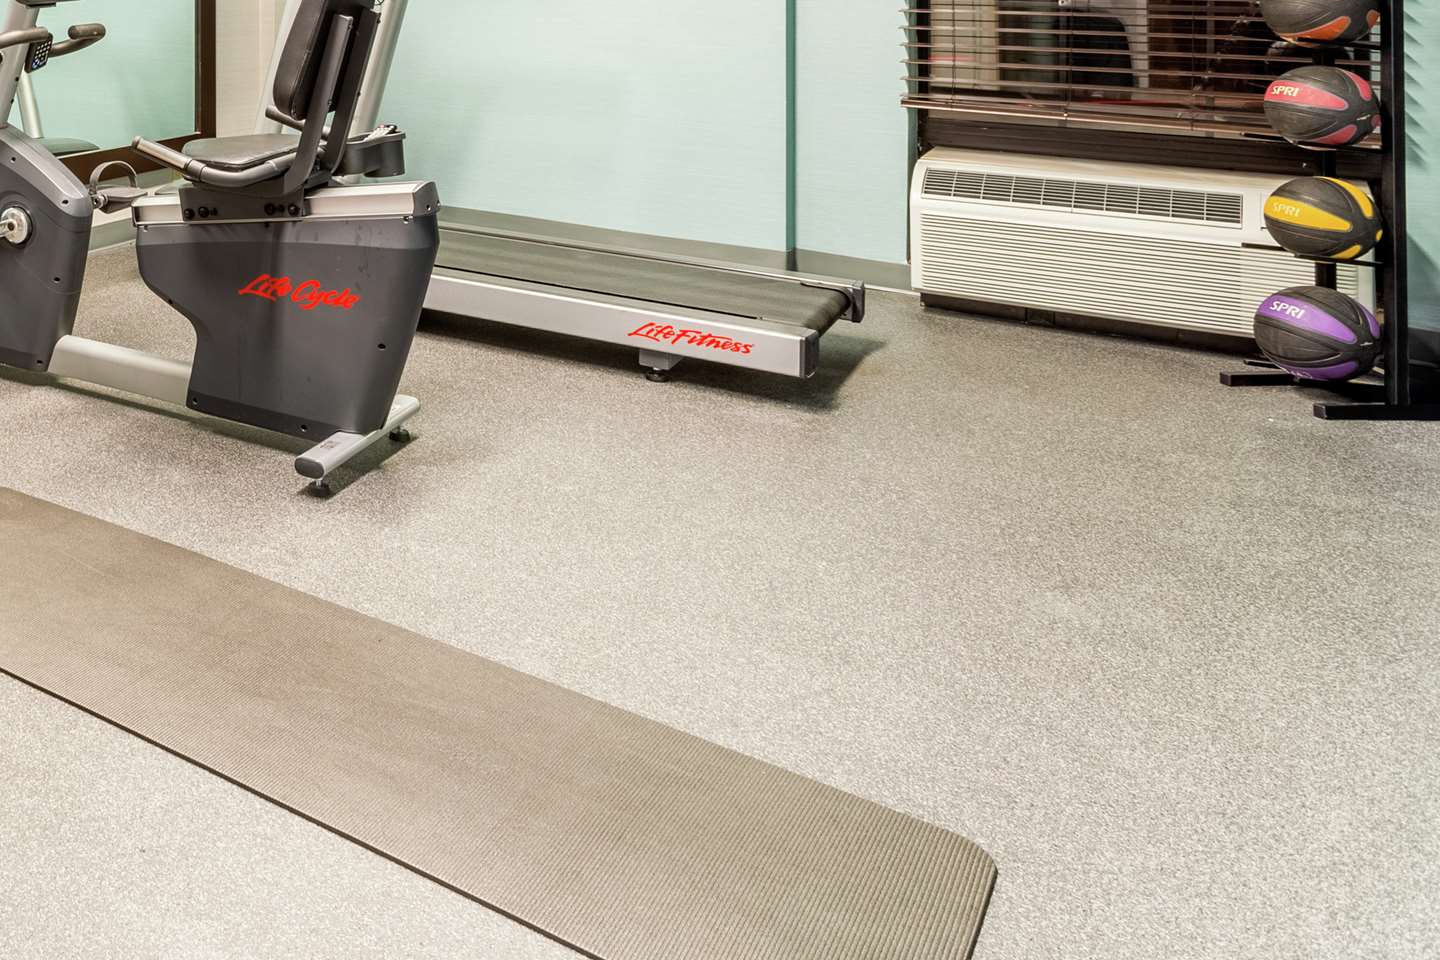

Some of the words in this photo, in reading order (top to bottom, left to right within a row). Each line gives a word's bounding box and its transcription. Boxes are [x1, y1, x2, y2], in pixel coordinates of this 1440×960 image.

[1271, 85, 1301, 97] SPRI
[1272, 202, 1301, 217] SPRI
[1269, 300, 1305, 320] SPRI
